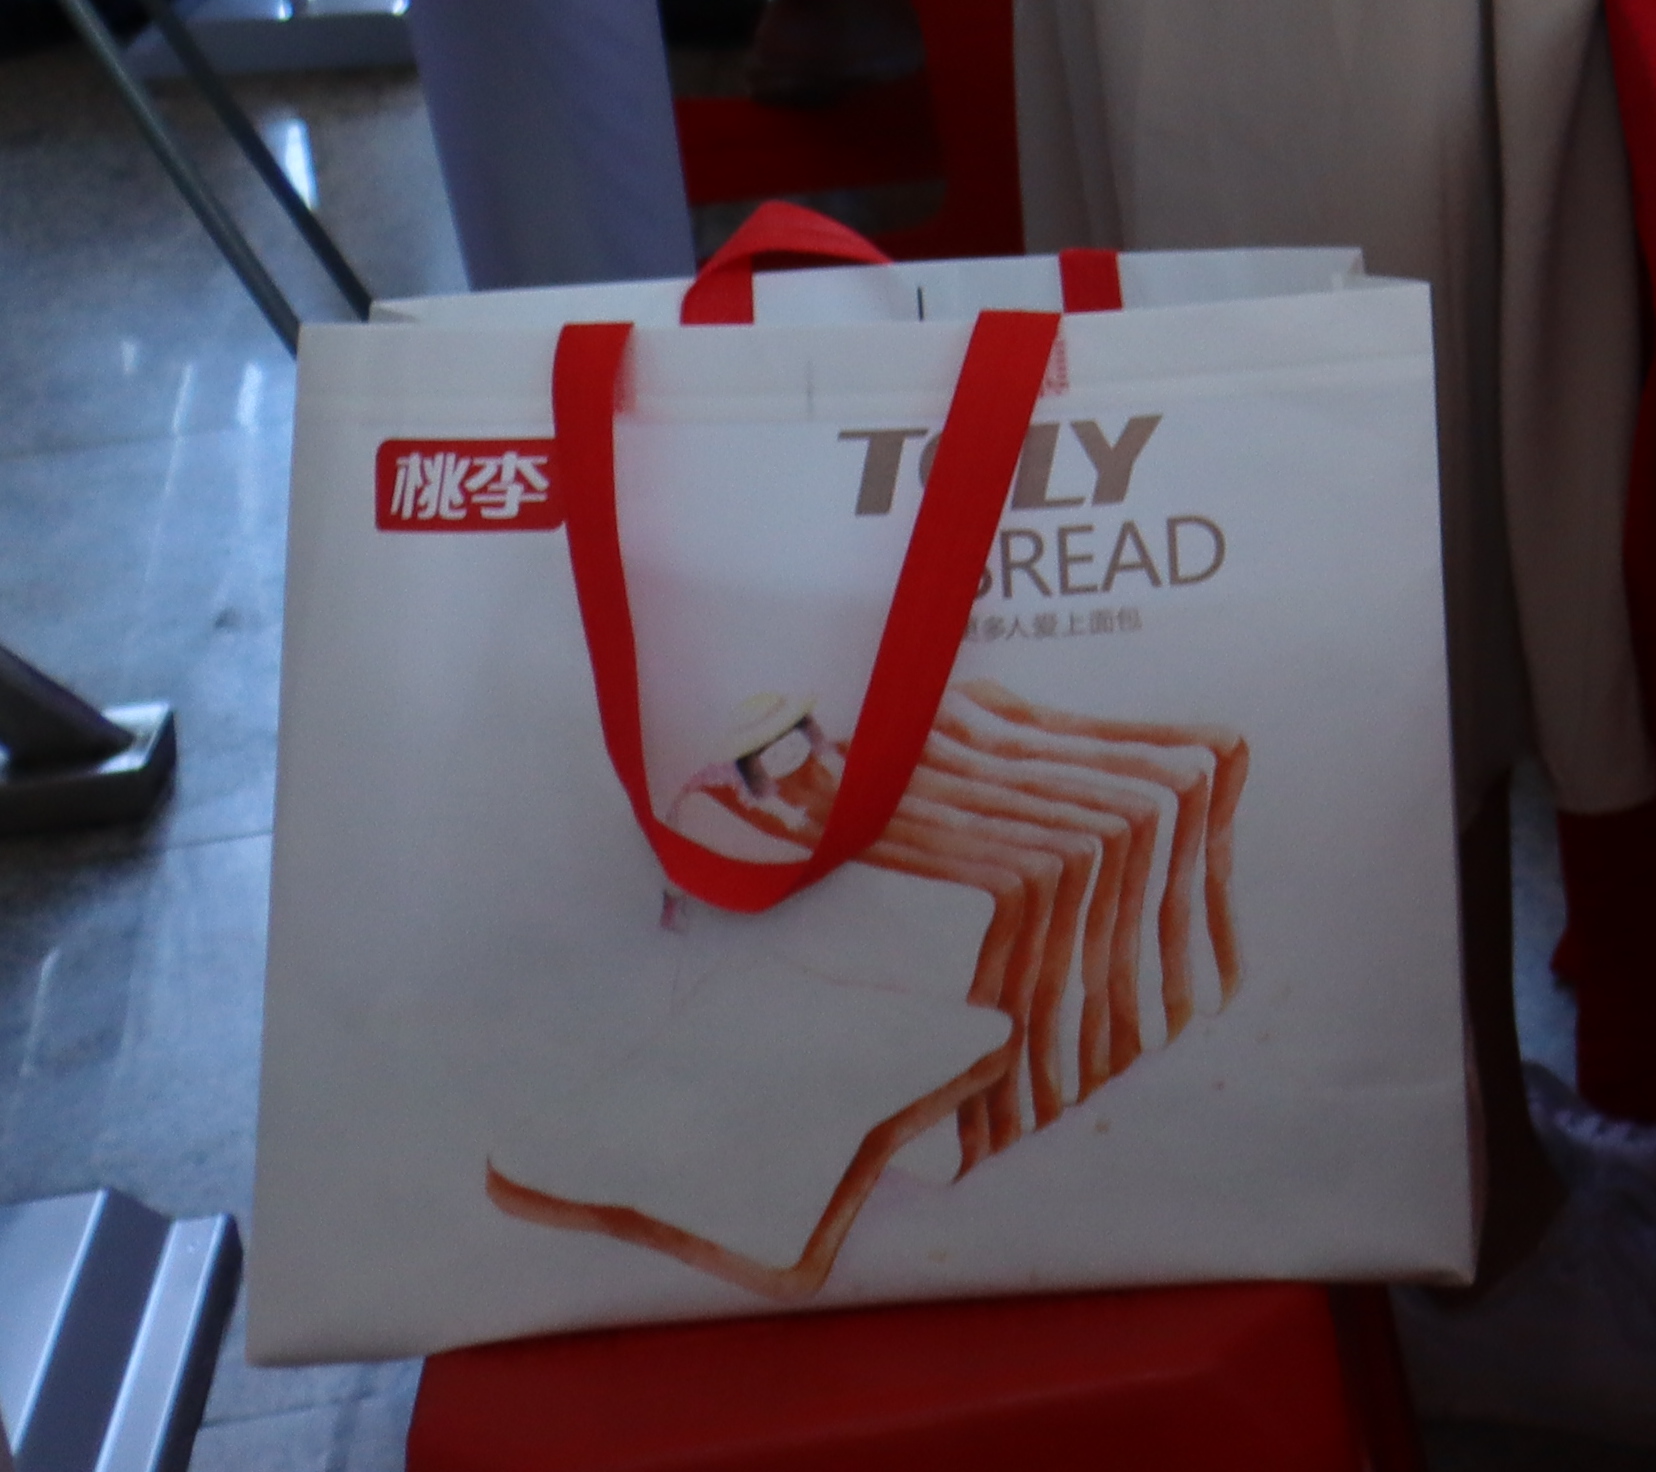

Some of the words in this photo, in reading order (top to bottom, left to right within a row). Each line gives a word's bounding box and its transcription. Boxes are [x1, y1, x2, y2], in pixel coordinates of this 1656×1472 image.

[390, 451, 550, 520] 桃李
[838, 413, 1163, 517] TLY
[975, 513, 1227, 601] READ
